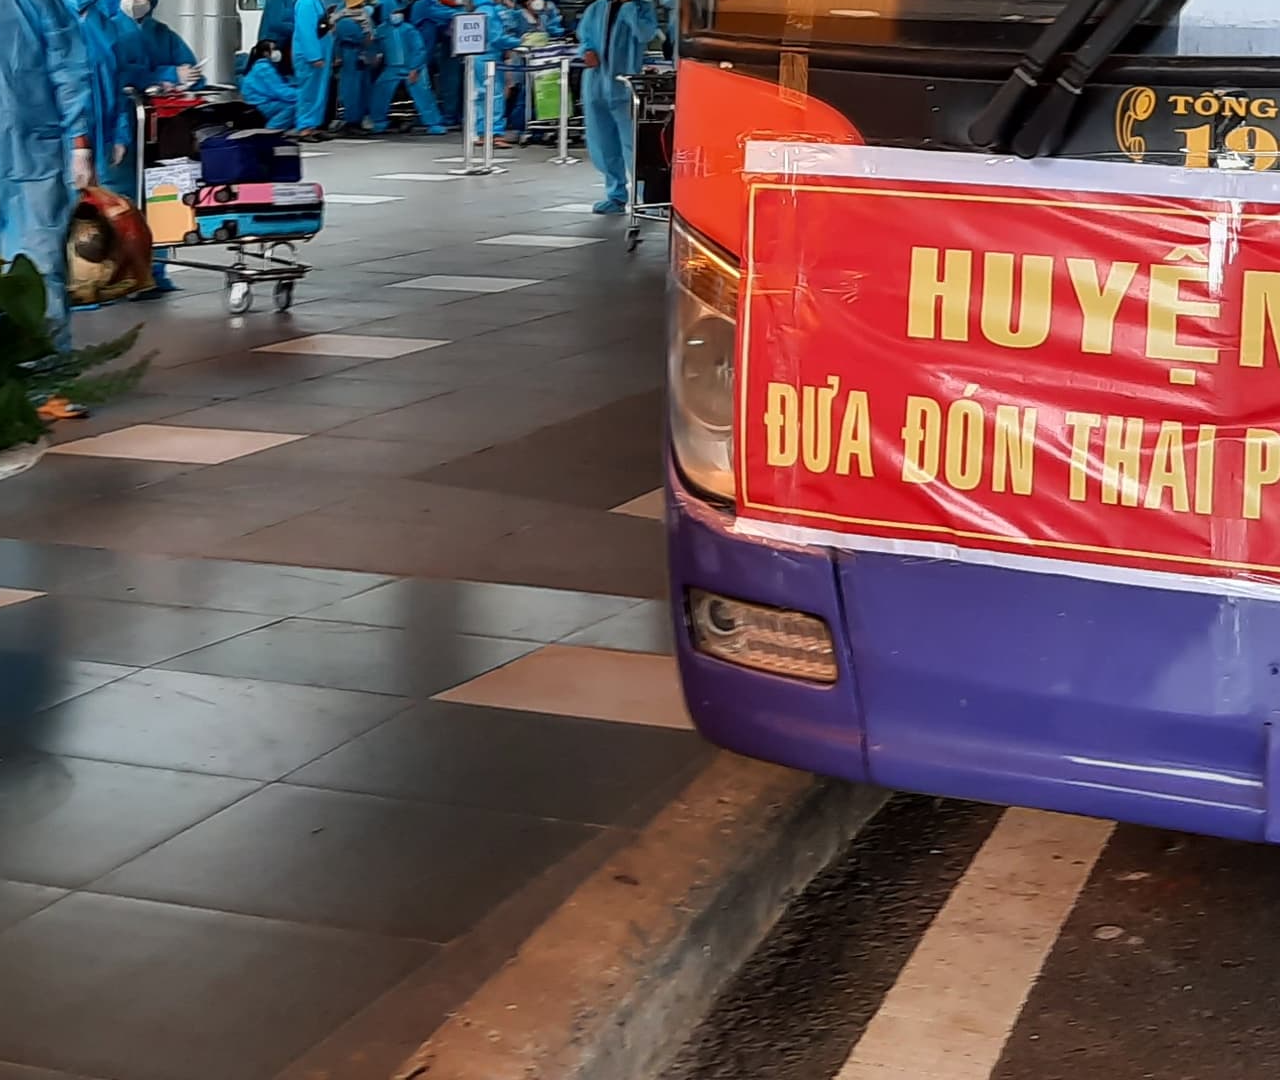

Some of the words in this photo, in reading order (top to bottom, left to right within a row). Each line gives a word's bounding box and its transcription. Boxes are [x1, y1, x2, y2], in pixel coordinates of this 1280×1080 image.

[763, 374, 874, 480] ĐƯA
[900, 383, 1039, 498] ĐÓN
[1064, 410, 1217, 516] THAI
